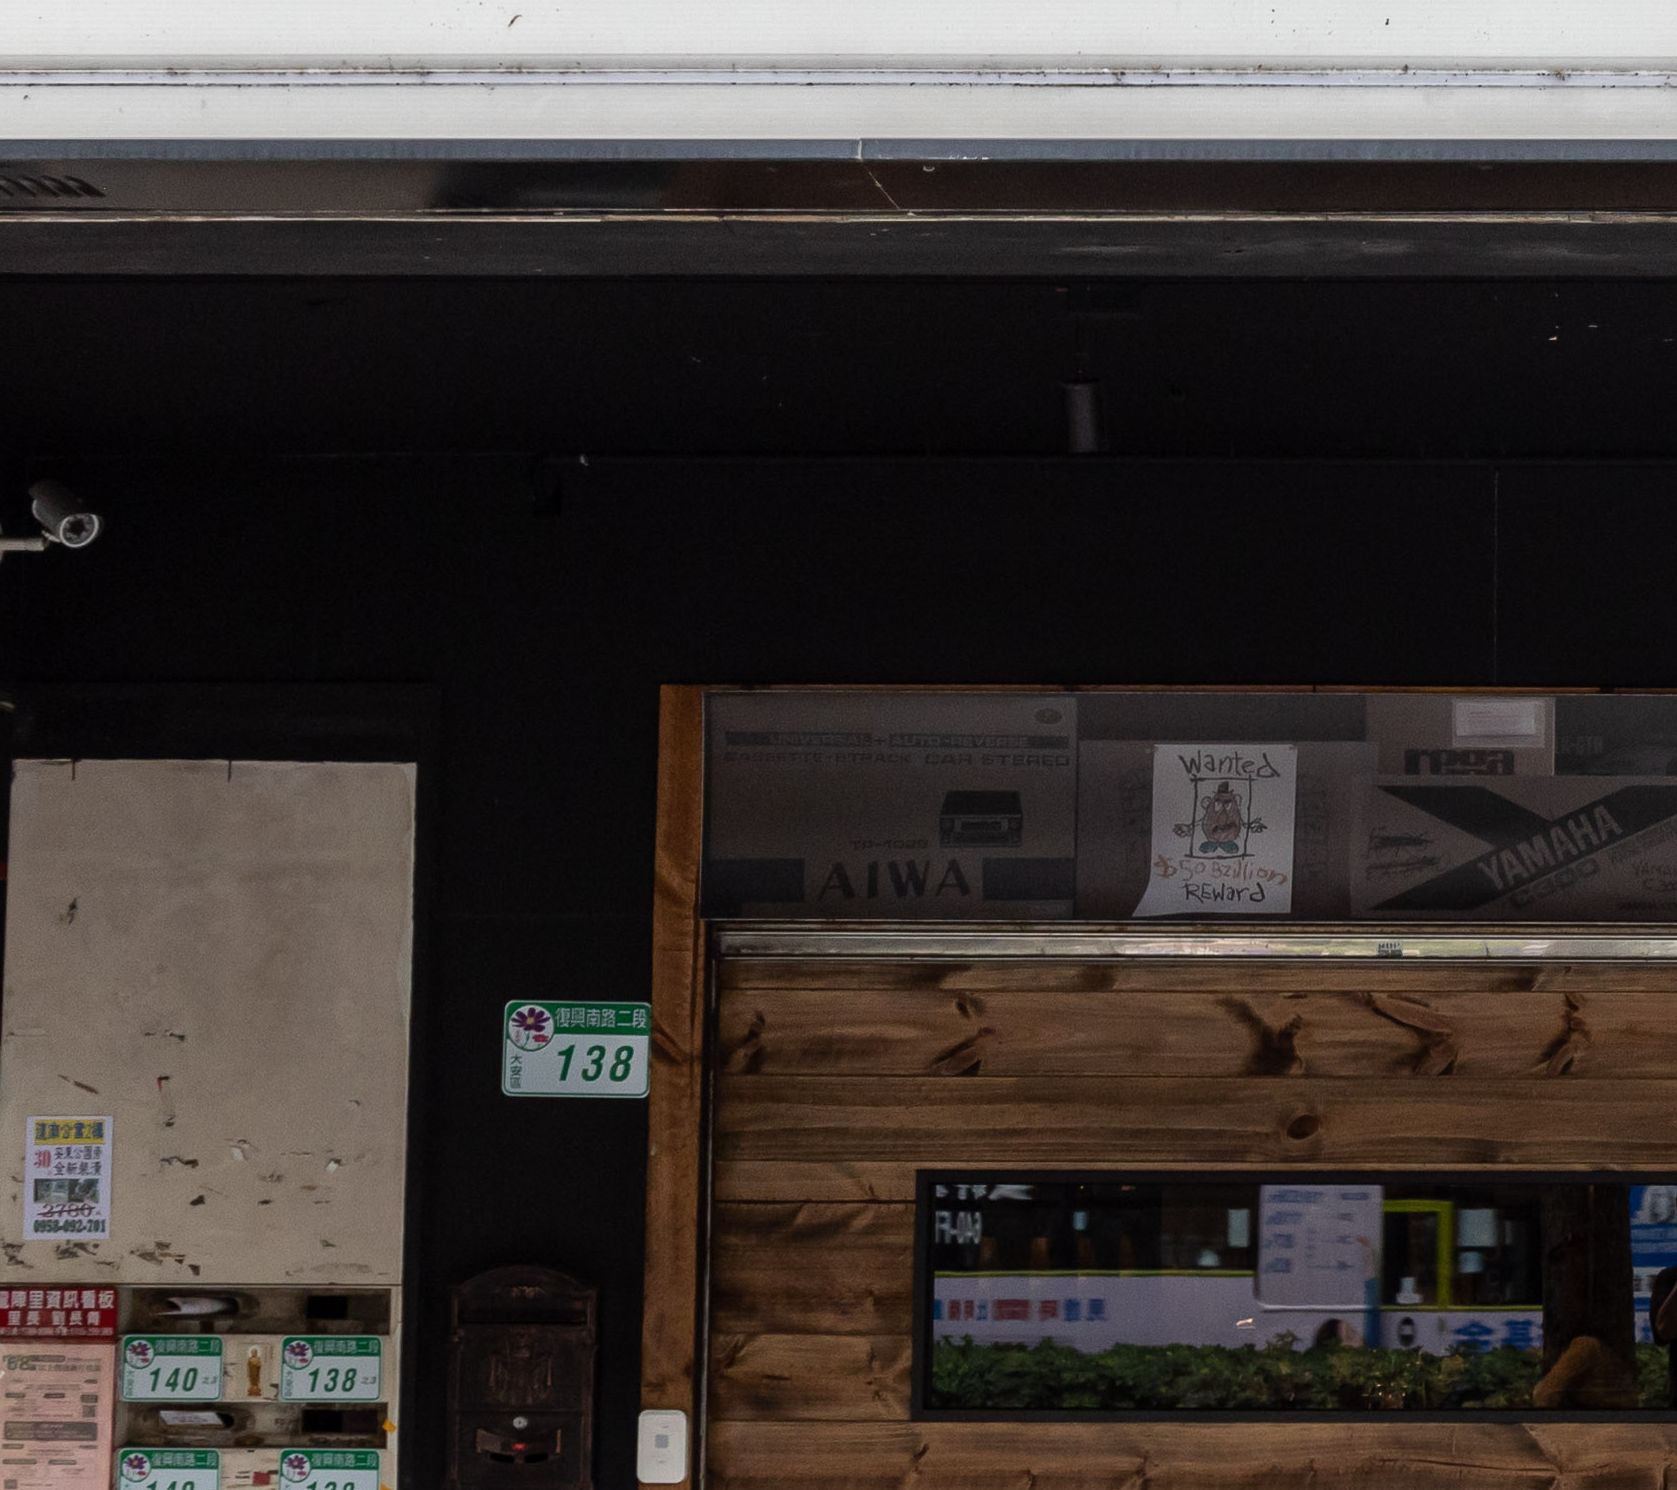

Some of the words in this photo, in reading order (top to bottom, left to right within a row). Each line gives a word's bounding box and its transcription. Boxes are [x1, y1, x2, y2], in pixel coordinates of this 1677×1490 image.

[924, 753, 973, 766] CAR
[981, 753, 1070, 767] STEREO
[1178, 750, 1281, 778] Wanted
[1477, 805, 1622, 888] YAMAHA
[817, 858, 971, 900] AIWA
[555, 1007, 647, 1029] 復興南路二段
[510, 1054, 522, 1089] 大安區
[557, 1044, 634, 1082] 138
[154, 1339, 221, 1355] 復興南路二段
[313, 1340, 380, 1356] 復興南路二段
[149, 1367, 198, 1392] 140
[307, 1367, 357, 1393] 138
[150, 1452, 218, 1467] 復興南路二段
[311, 1452, 378, 1467] 復興南路二段
